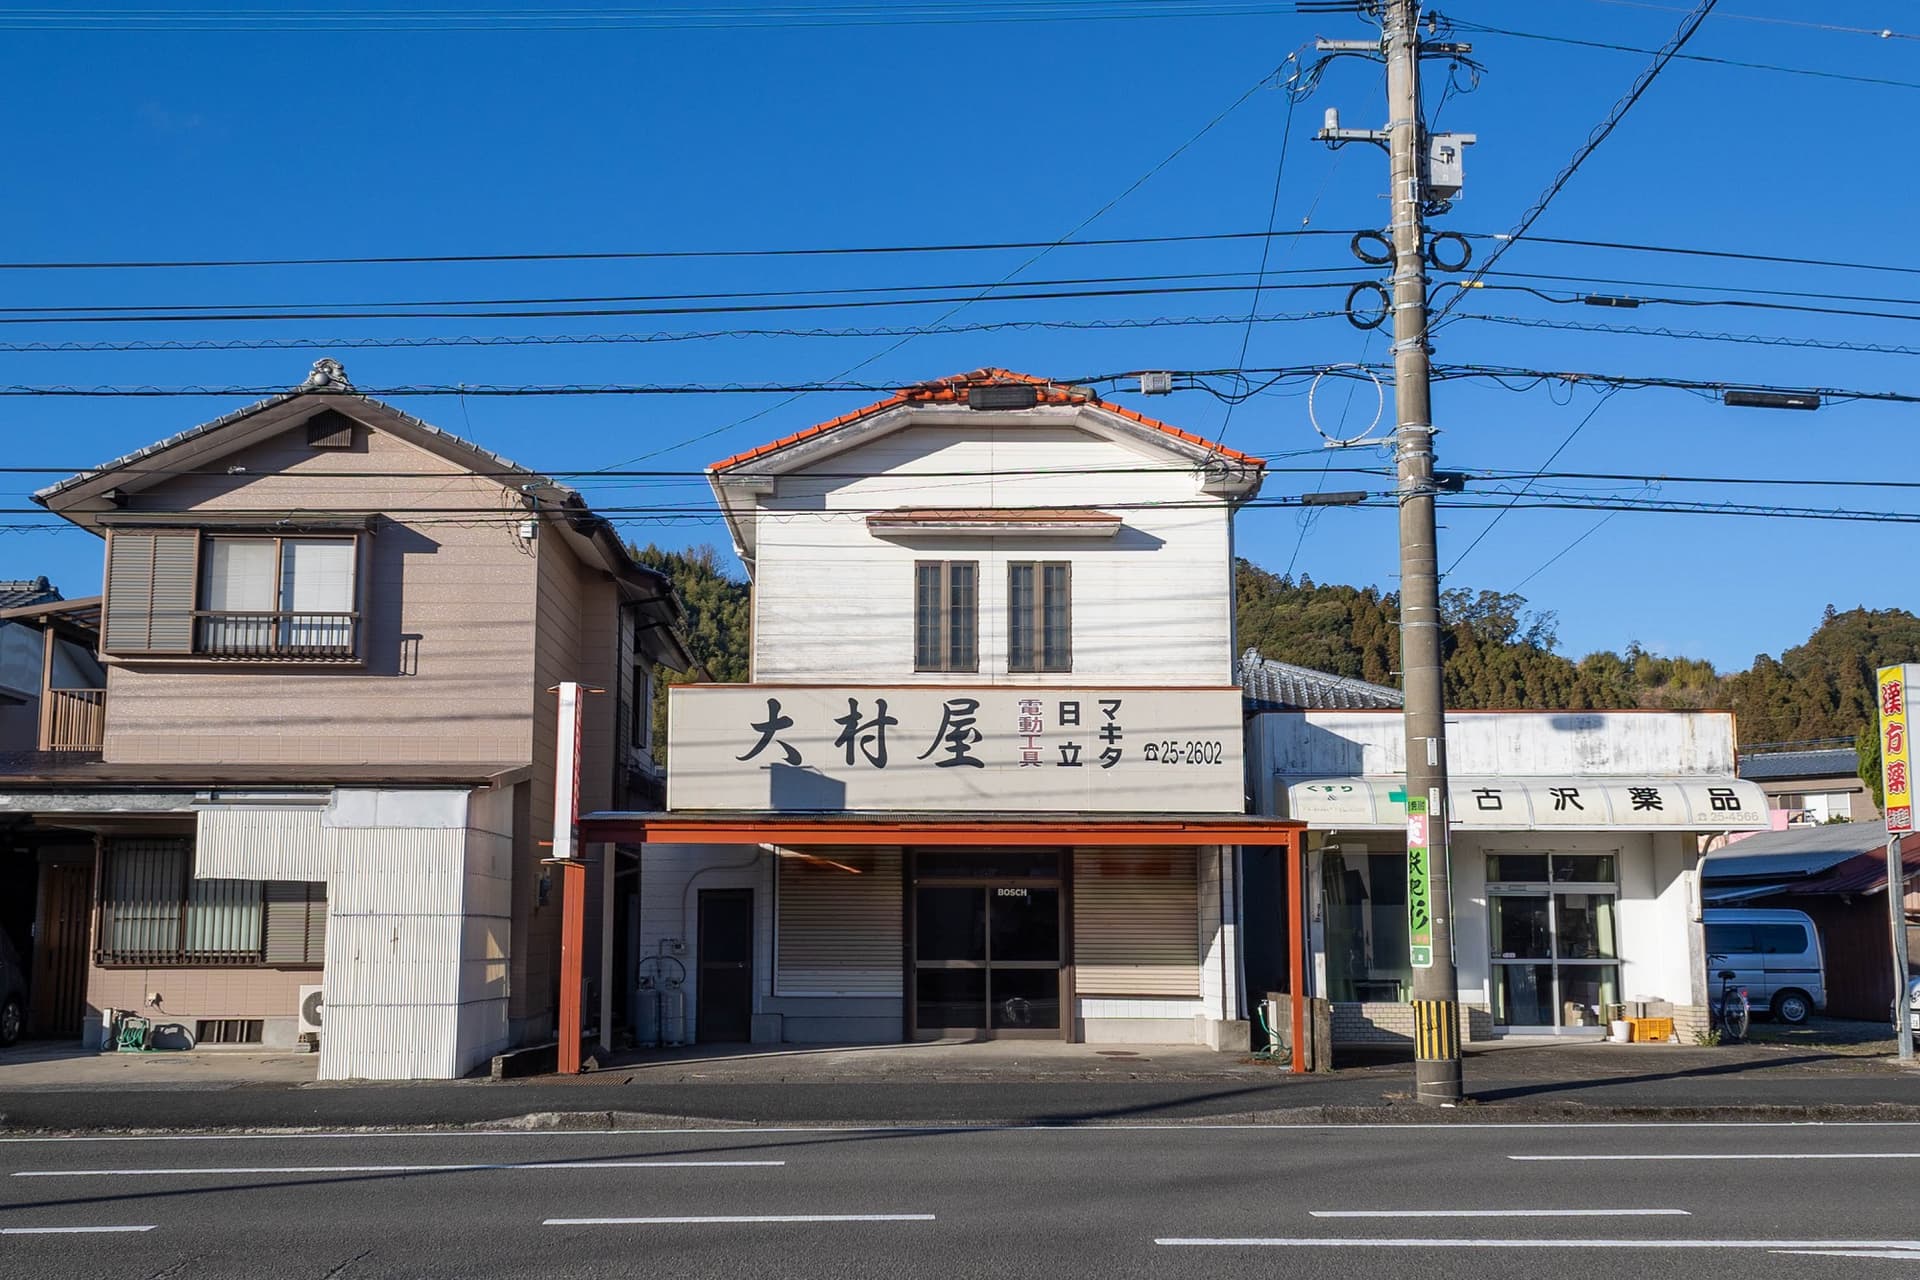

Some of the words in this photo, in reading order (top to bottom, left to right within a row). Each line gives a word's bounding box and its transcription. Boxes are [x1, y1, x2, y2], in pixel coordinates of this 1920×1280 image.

[735, 698, 985, 769] 大村屋
[1018, 699, 1043, 767] 電動工具
[1056, 701, 1083, 767] 日立
[1098, 699, 1123, 769] マキタ
[1882, 680, 1906, 794] 漢方薬
[1471, 787, 1742, 811] 古沢薬品
[997, 888, 1028, 897] BOSCH
